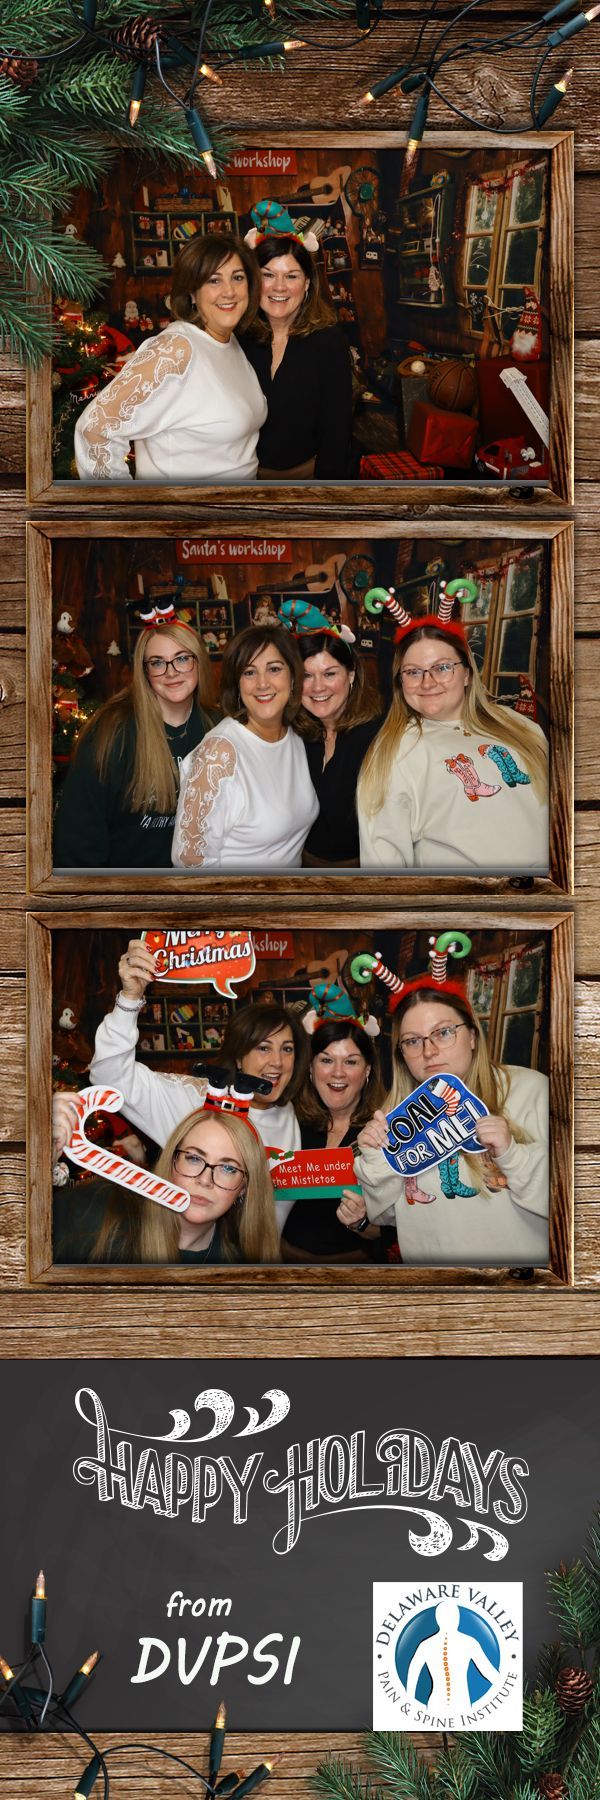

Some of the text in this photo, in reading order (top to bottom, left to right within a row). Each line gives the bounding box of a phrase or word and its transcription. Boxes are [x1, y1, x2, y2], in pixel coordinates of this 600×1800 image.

[233, 150, 291, 172] workshop
[182, 540, 286, 560] Santa's workshop
[252, 933, 288, 957] kshop
[153, 941, 251, 977] Christmas
[280, 1161, 351, 1174] Meet Me under
[396, 1142, 435, 1172] FOR
[291, 1175, 336, 1185] Mistletoe
